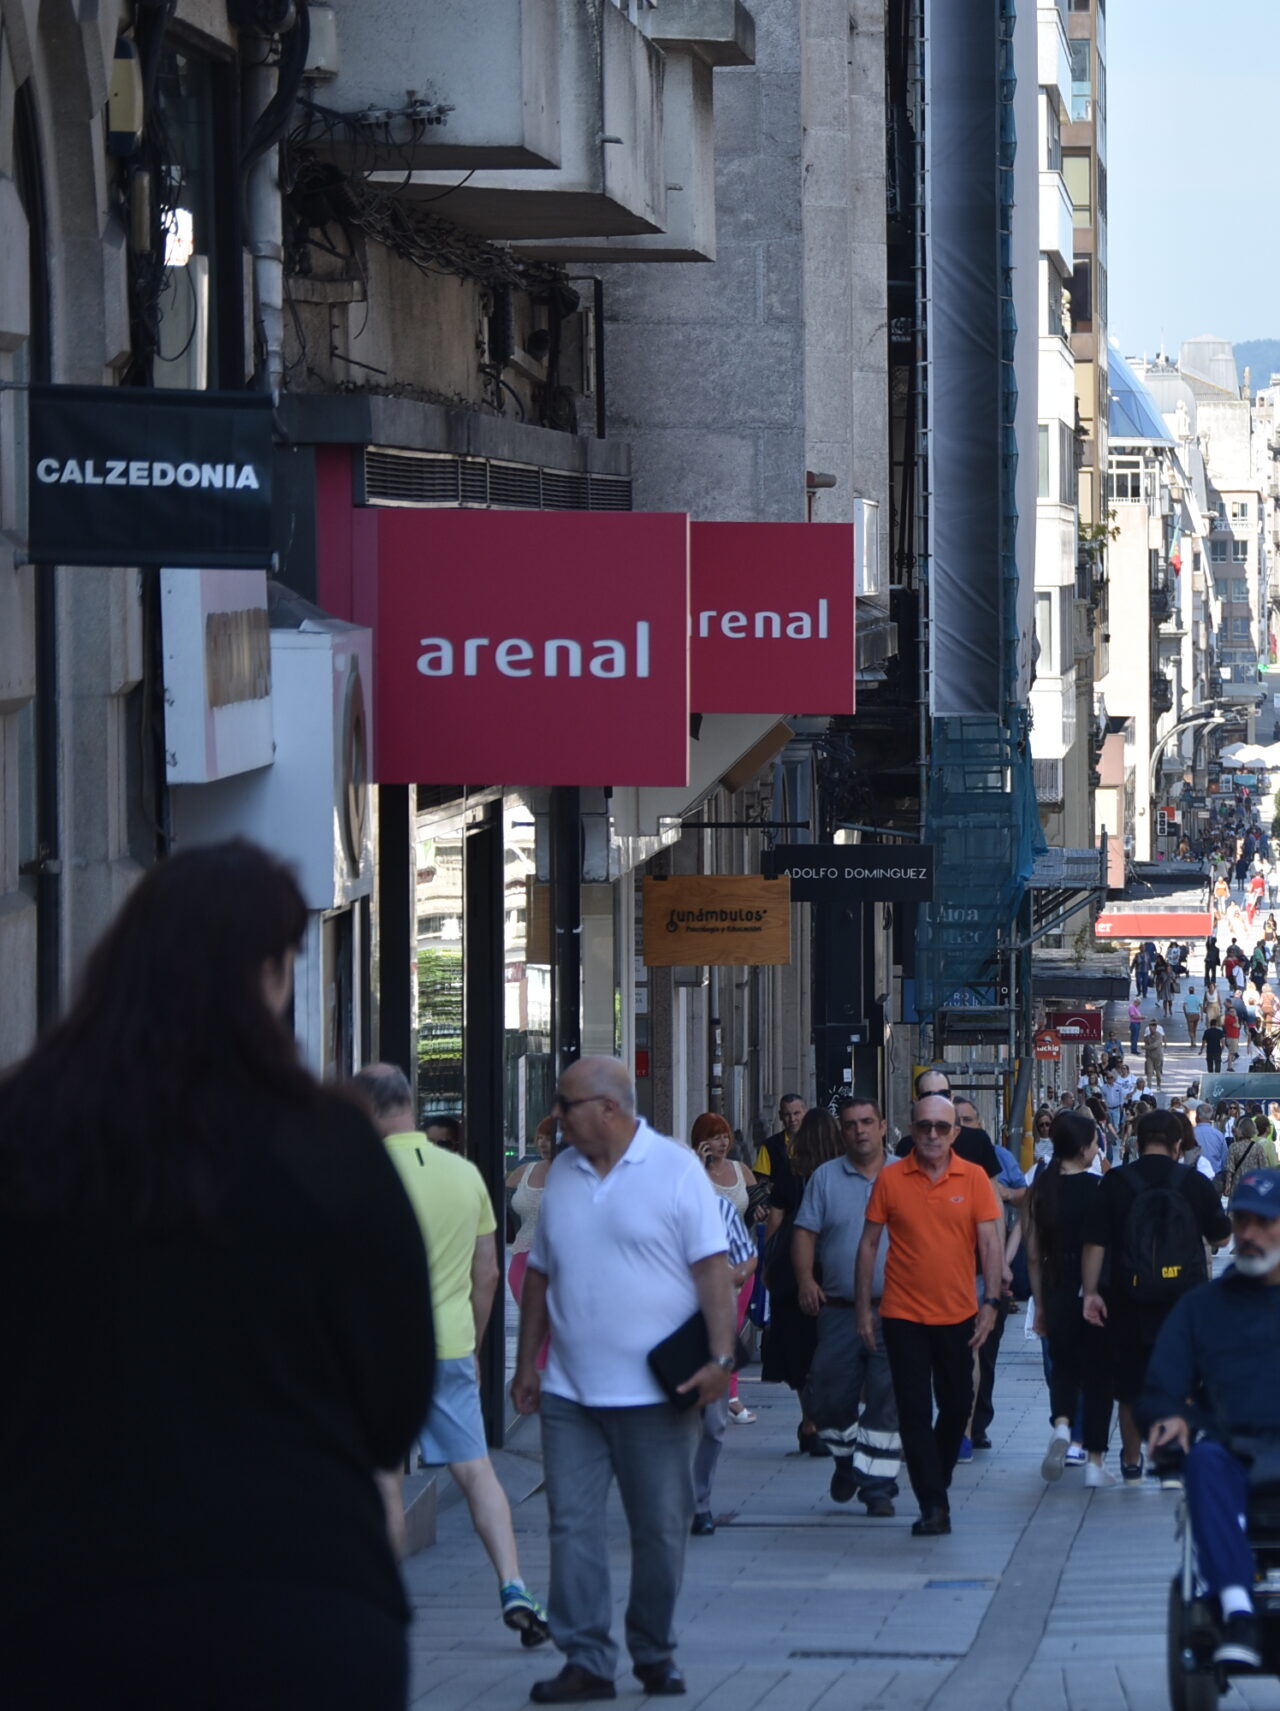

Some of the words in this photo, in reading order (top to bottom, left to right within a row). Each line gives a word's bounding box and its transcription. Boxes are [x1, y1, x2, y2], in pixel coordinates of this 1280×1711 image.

[36, 457, 260, 490] CALZEDONIA
[690, 598, 829, 639] renal
[416, 620, 650, 679] arenal
[784, 867, 838, 879] ADOLFO
[844, 867, 928, 879] DOMINGUEZ
[1161, 1266, 1179, 1279] CAT
